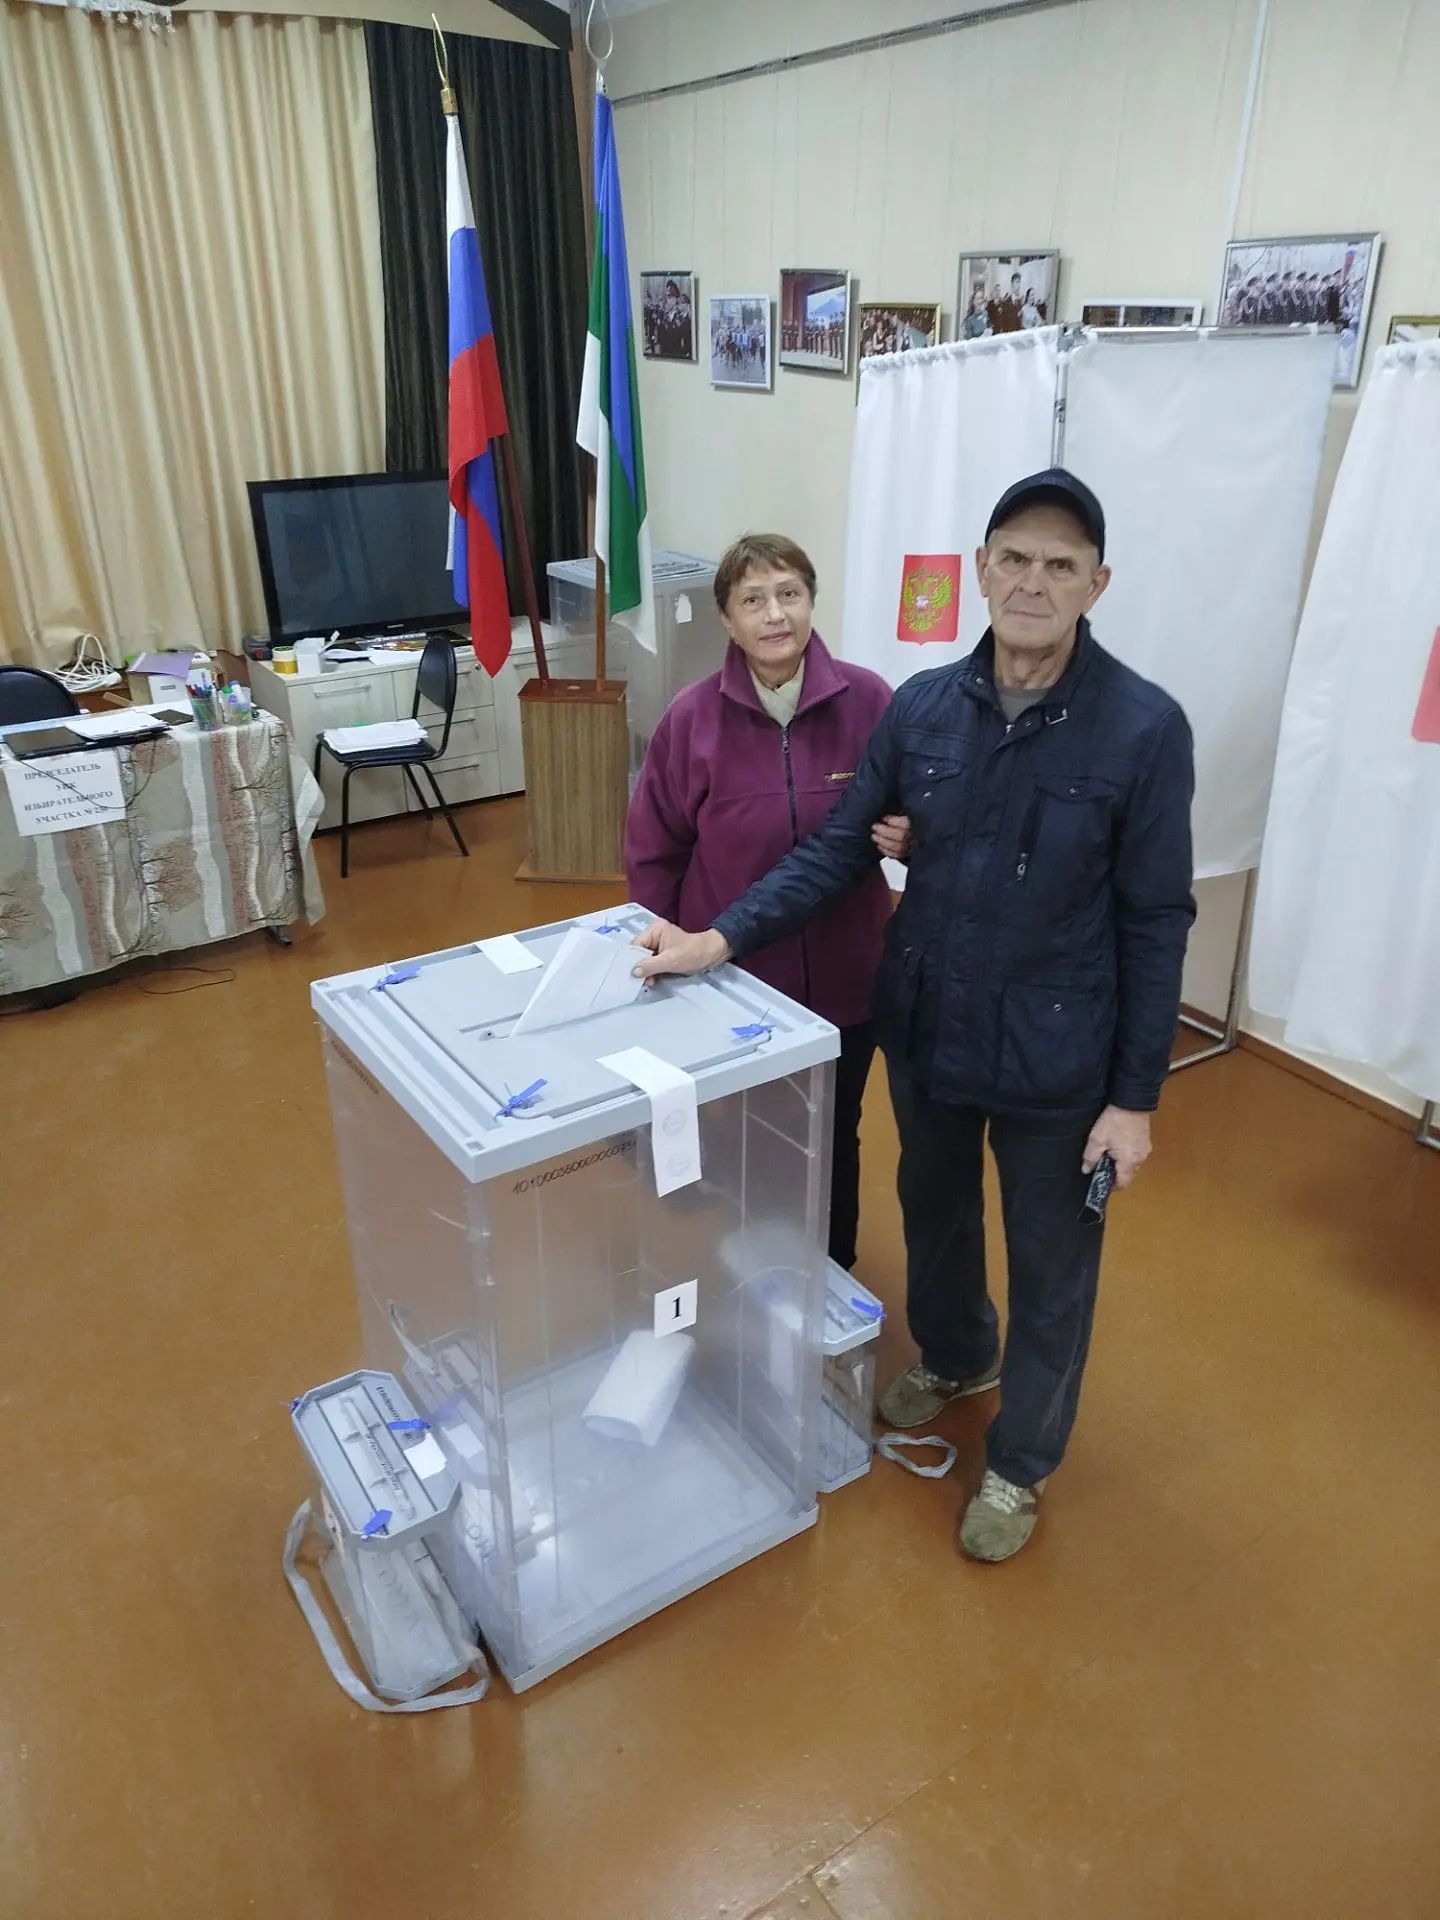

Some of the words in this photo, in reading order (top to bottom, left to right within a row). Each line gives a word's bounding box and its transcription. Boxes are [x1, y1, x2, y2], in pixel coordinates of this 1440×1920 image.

[24, 763, 101, 780] ПРЕДСЕДАТЕЛЬ
[24, 791, 113, 811] ИЗБИРАТЕЛЬНОГО
[34, 811, 82, 824] УЧАСТКА
[672, 1296, 681, 1319] 1
